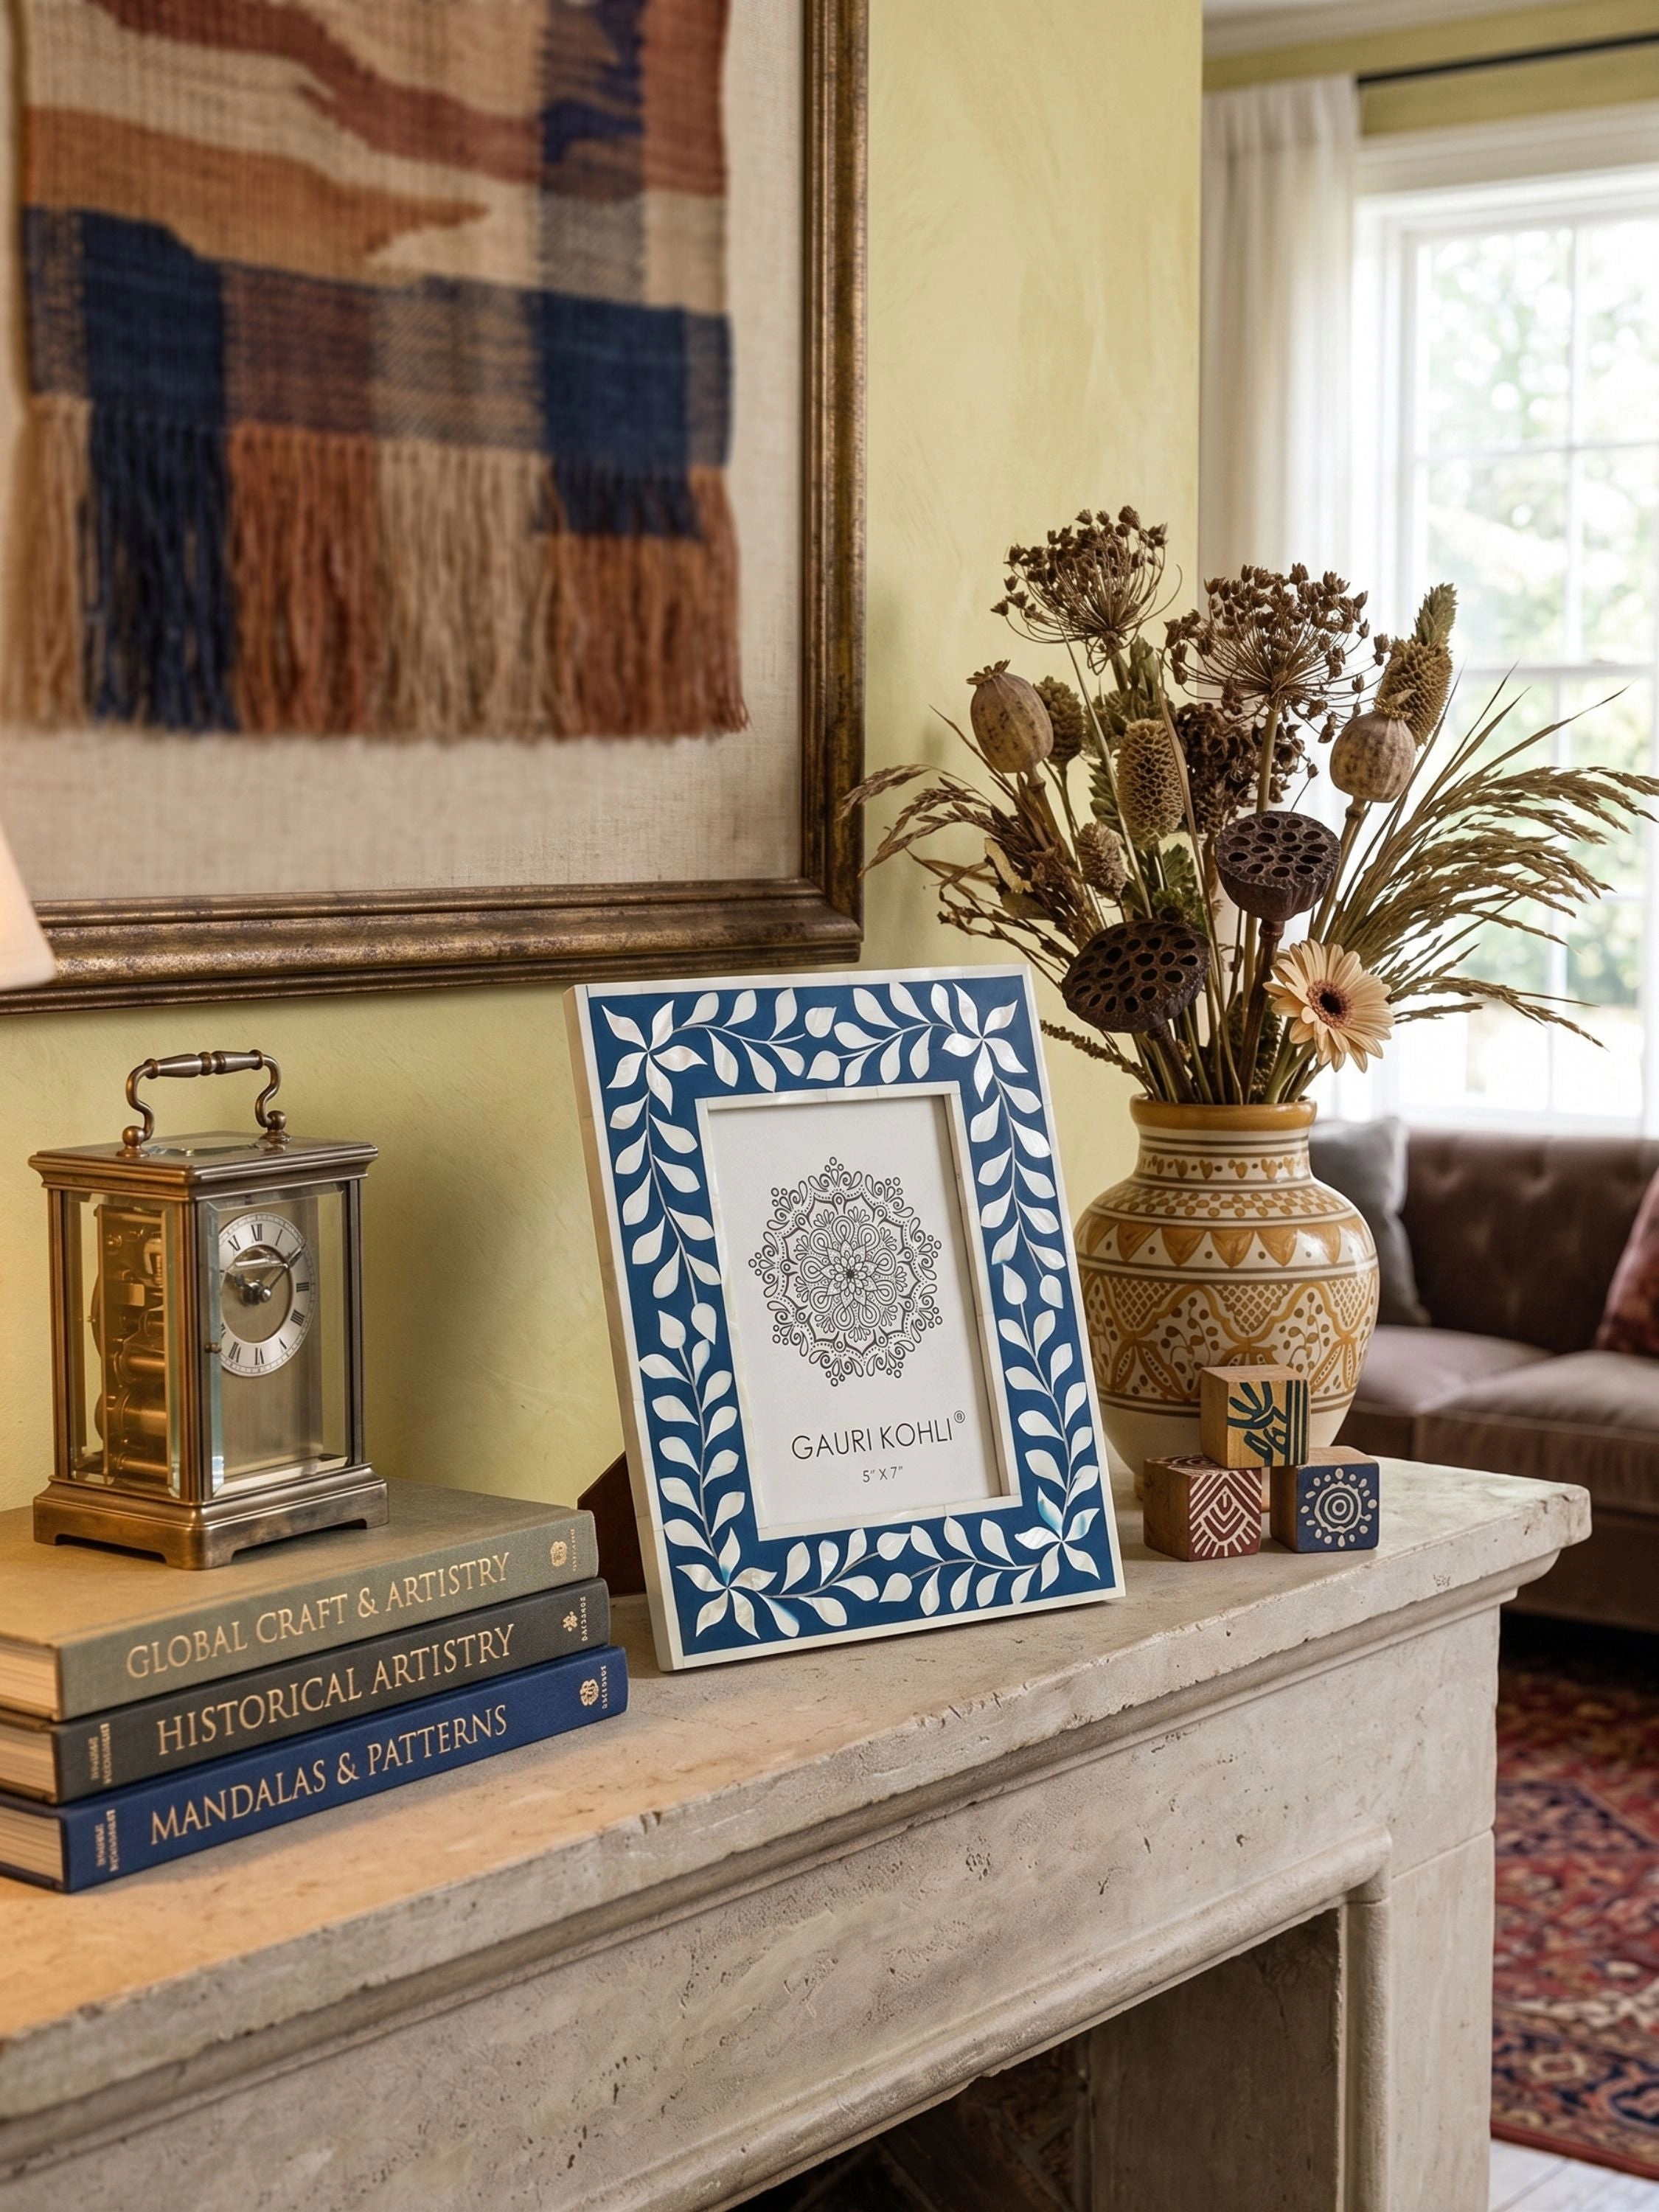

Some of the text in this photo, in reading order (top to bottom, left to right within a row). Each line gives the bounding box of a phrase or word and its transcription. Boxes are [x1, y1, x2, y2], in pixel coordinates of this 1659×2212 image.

[791, 1427, 872, 1460] GAURI
[126, 1552, 509, 1678] GLOBAL CRAFT & ARTISTRY
[156, 1667, 362, 1756] HISTORICAL
[371, 1624, 514, 1694] ARTISTRY
[151, 1759, 327, 1845] MANDALAS
[337, 1752, 360, 1784] &
[367, 1704, 507, 1776] PATTERNS
